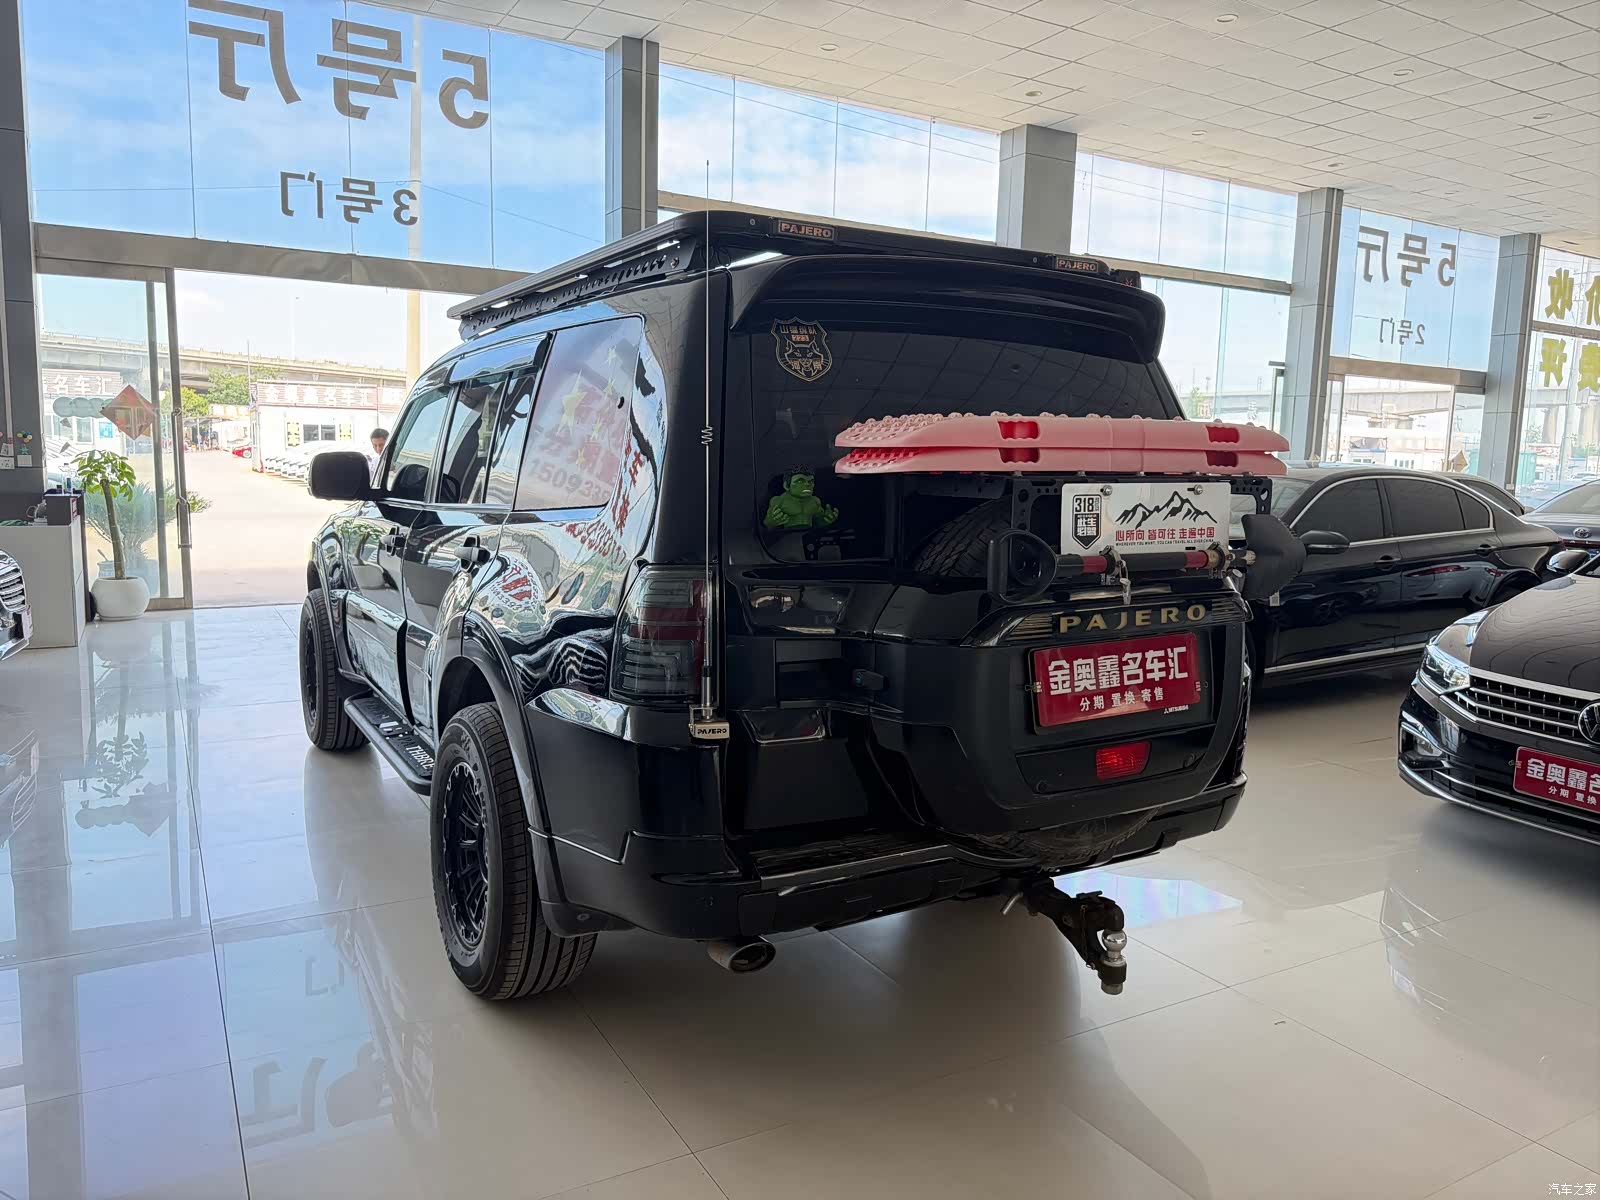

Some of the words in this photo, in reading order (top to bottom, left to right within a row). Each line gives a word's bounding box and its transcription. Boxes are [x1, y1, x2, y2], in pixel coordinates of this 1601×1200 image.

[781, 222, 832, 238] PAJERO
[1058, 259, 1097, 271] PAJERO
[1074, 497, 1094, 513] 318
[1115, 529, 1145, 541] 心所向
[1148, 528, 1176, 541] 皆可往
[1178, 526, 1215, 539] 走遍中国
[1059, 604, 1206, 633] PAJERO
[1048, 646, 1188, 696] 金奥鑫名车汇
[1080, 695, 1104, 712] 分期
[1111, 690, 1136, 708] 置换
[1141, 686, 1164, 703] 寄售
[1548, 785, 1569, 799] 分期
[1575, 792, 1597, 806] 置换
